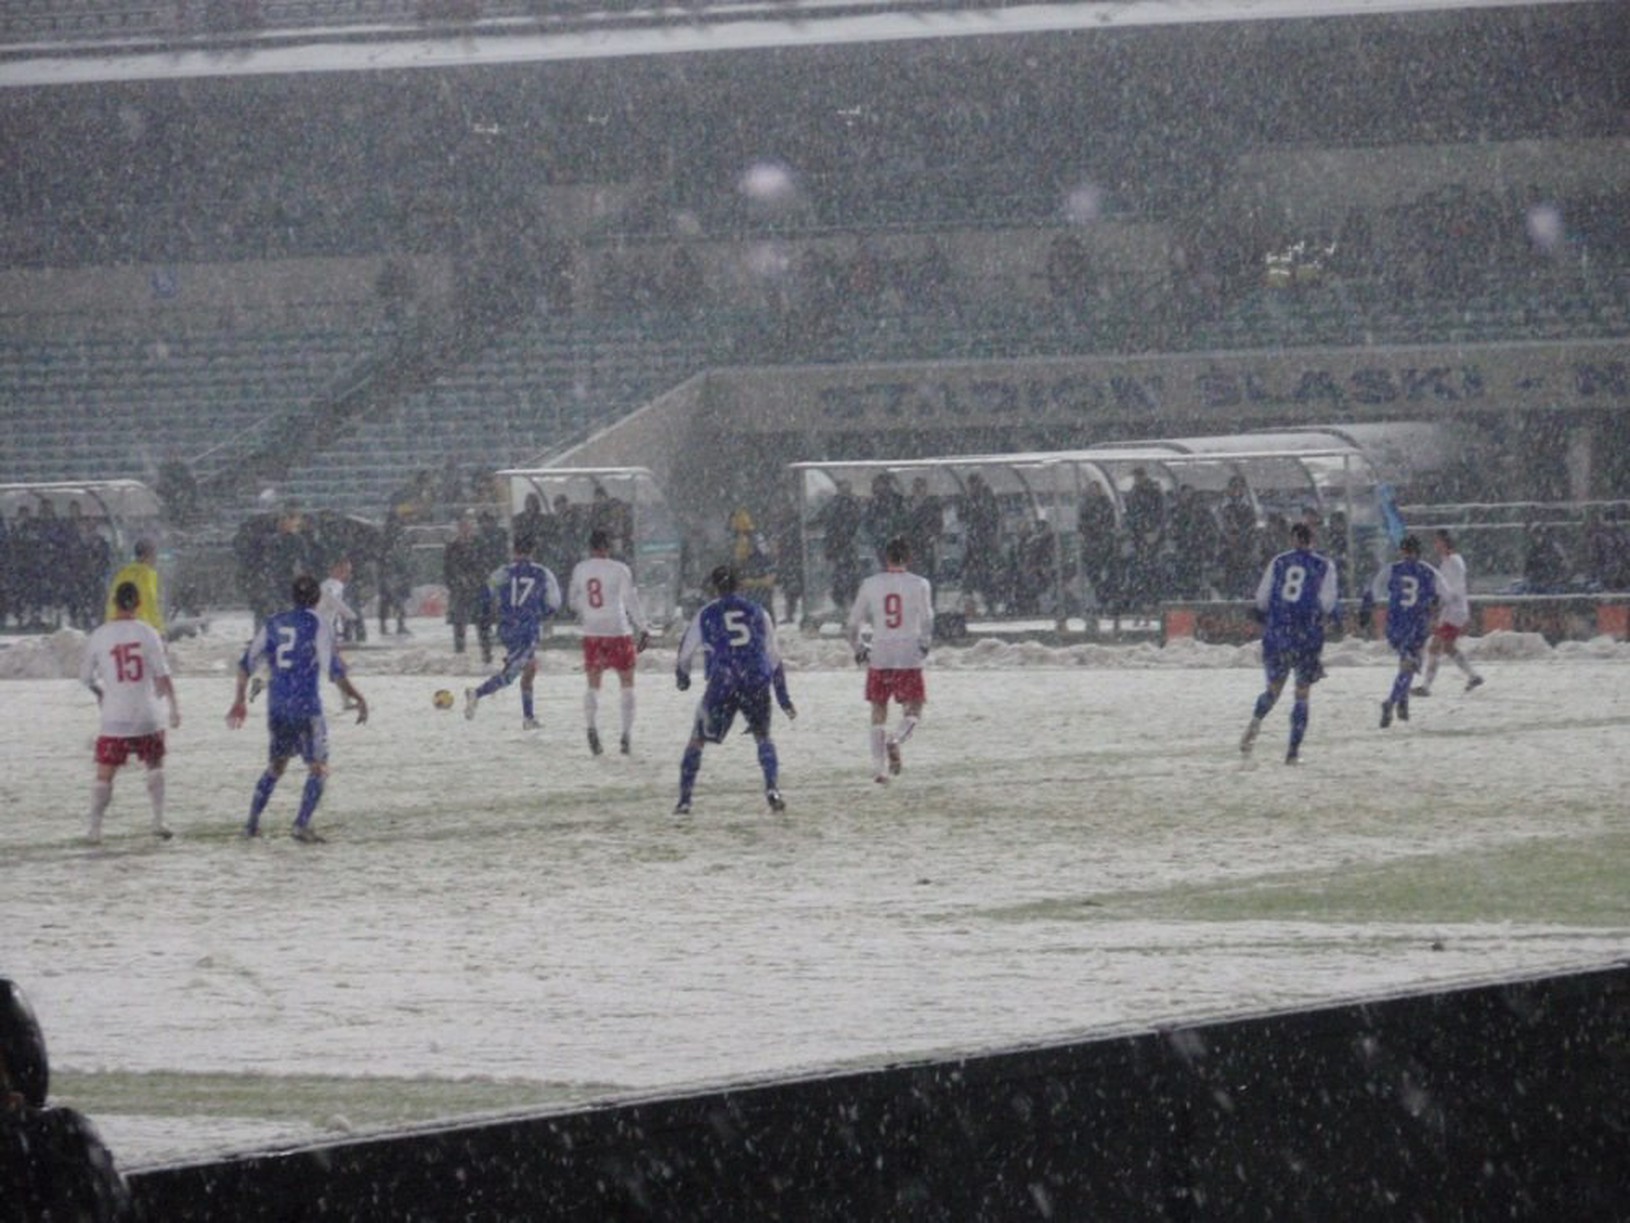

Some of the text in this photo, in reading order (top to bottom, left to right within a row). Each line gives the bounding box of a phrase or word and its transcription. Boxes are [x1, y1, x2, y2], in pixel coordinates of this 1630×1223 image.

[510, 576, 535, 607] 17
[587, 578, 604, 609] 8
[1282, 565, 1306, 604] 8
[1400, 576, 1419, 608] 3
[723, 610, 751, 648] 5
[884, 593, 903, 630] 9
[110, 643, 144, 683] 15
[276, 626, 297, 669] 2
